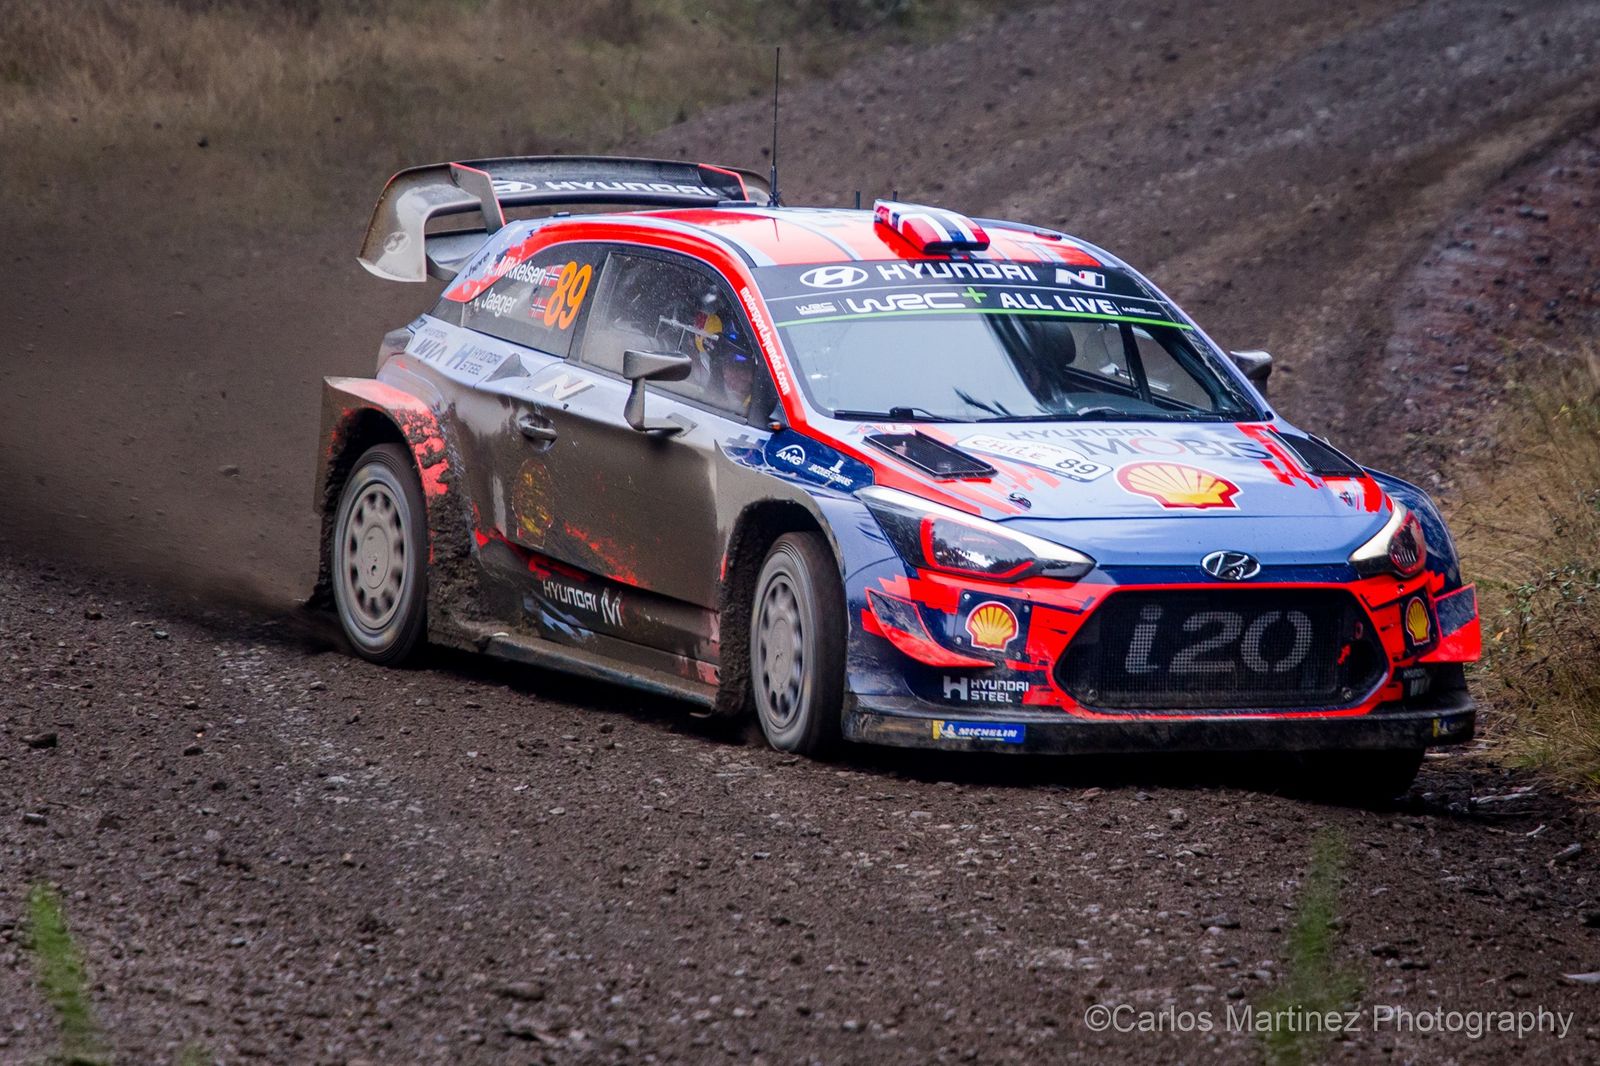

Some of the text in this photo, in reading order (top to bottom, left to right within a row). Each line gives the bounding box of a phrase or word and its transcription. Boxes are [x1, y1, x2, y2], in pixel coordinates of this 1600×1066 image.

[544, 181, 718, 197] HYUNDAI
[498, 255, 547, 286] Mikkelsen
[876, 262, 1038, 281] HYUNDAI
[481, 287, 517, 318] Jaeger
[543, 261, 593, 330] 89
[1000, 292, 1054, 311] ALL
[1053, 295, 1119, 316] LIVE
[740, 286, 791, 396] motorsport.hyundai.com
[1006, 428, 1158, 441] HYUNDAI
[972, 438, 1046, 461] CHILE
[1071, 437, 1274, 460] MOBIS
[1056, 458, 1099, 475] 89
[543, 580, 598, 612] HYUNDAI
[1125, 604, 1313, 674] i20
[970, 679, 1030, 692] HYUNDAI
[970, 690, 1013, 703] STEEL
[957, 727, 1018, 738] MICHELIN
